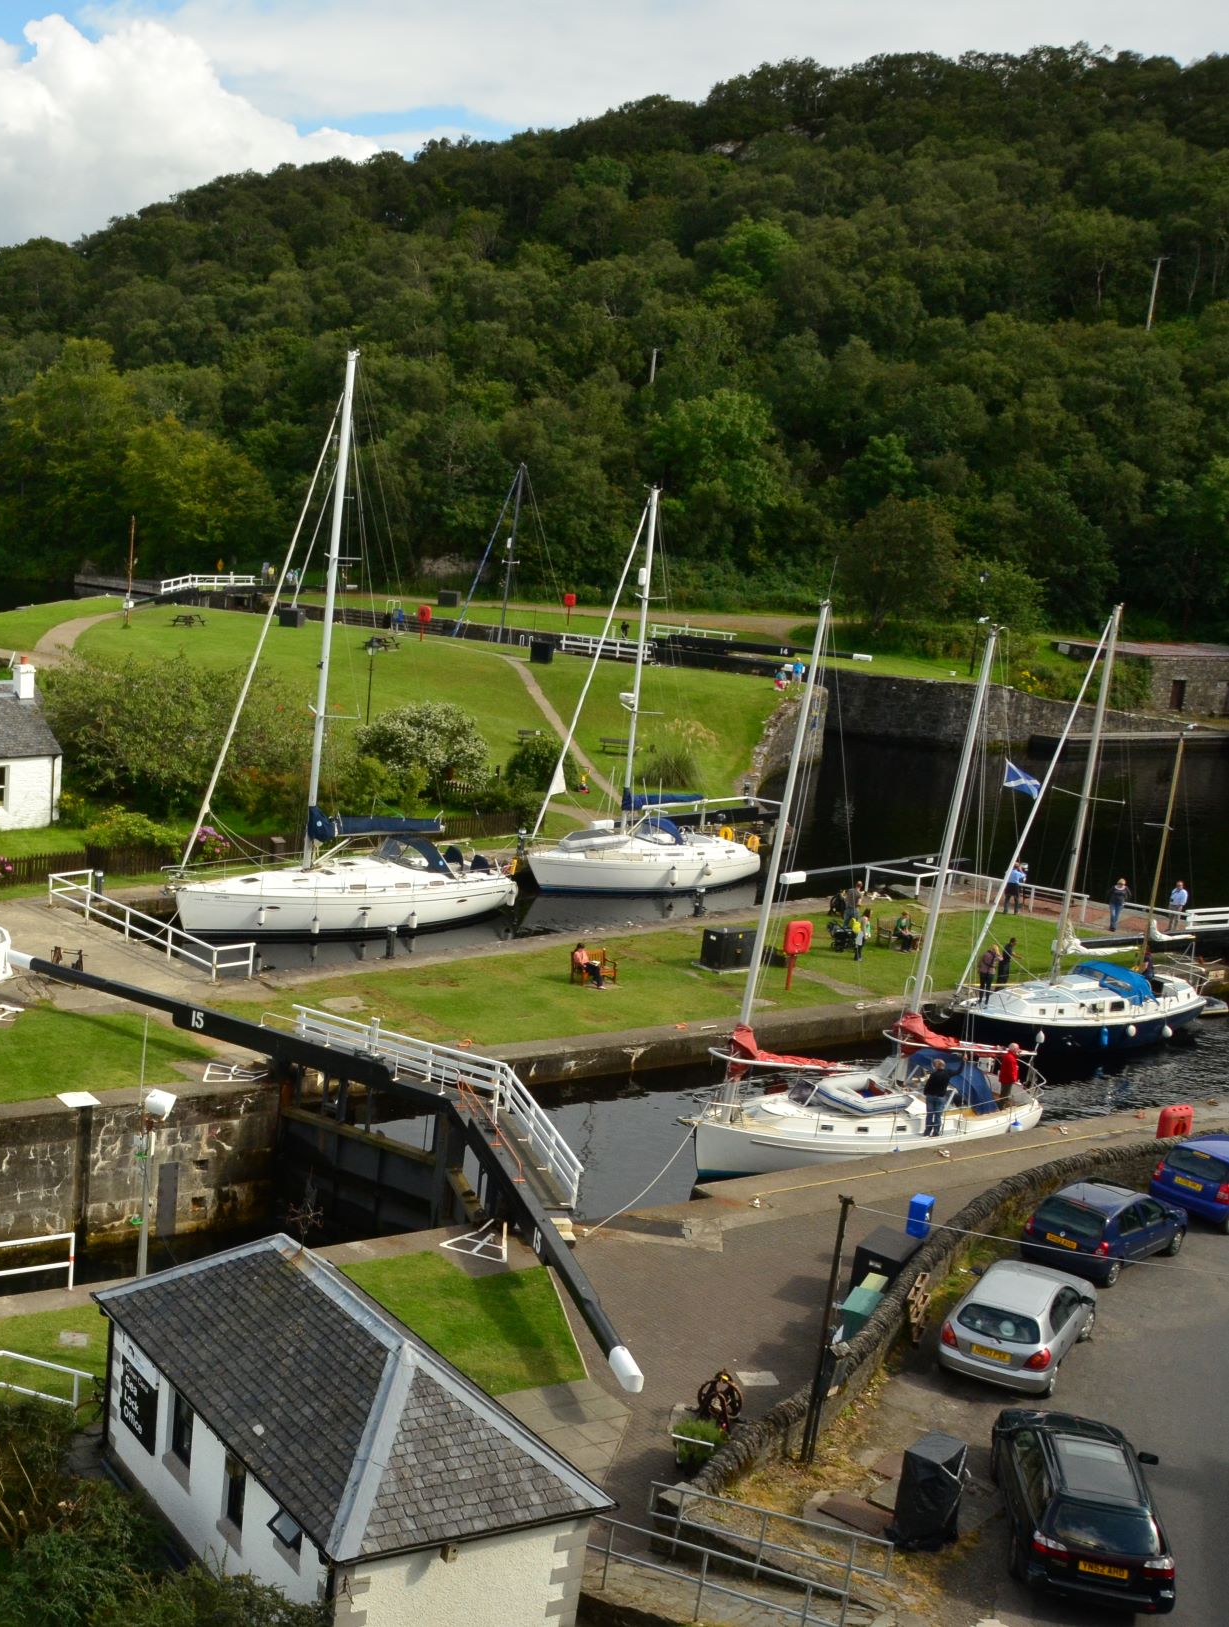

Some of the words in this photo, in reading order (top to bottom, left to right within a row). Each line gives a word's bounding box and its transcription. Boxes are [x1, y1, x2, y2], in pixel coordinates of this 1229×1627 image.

[191, 1010, 204, 1029] 15
[533, 1226, 542, 1254] 15
[125, 1374, 138, 1397] Sea
[124, 1388, 139, 1415] Lock
[123, 1405, 143, 1435] Office
